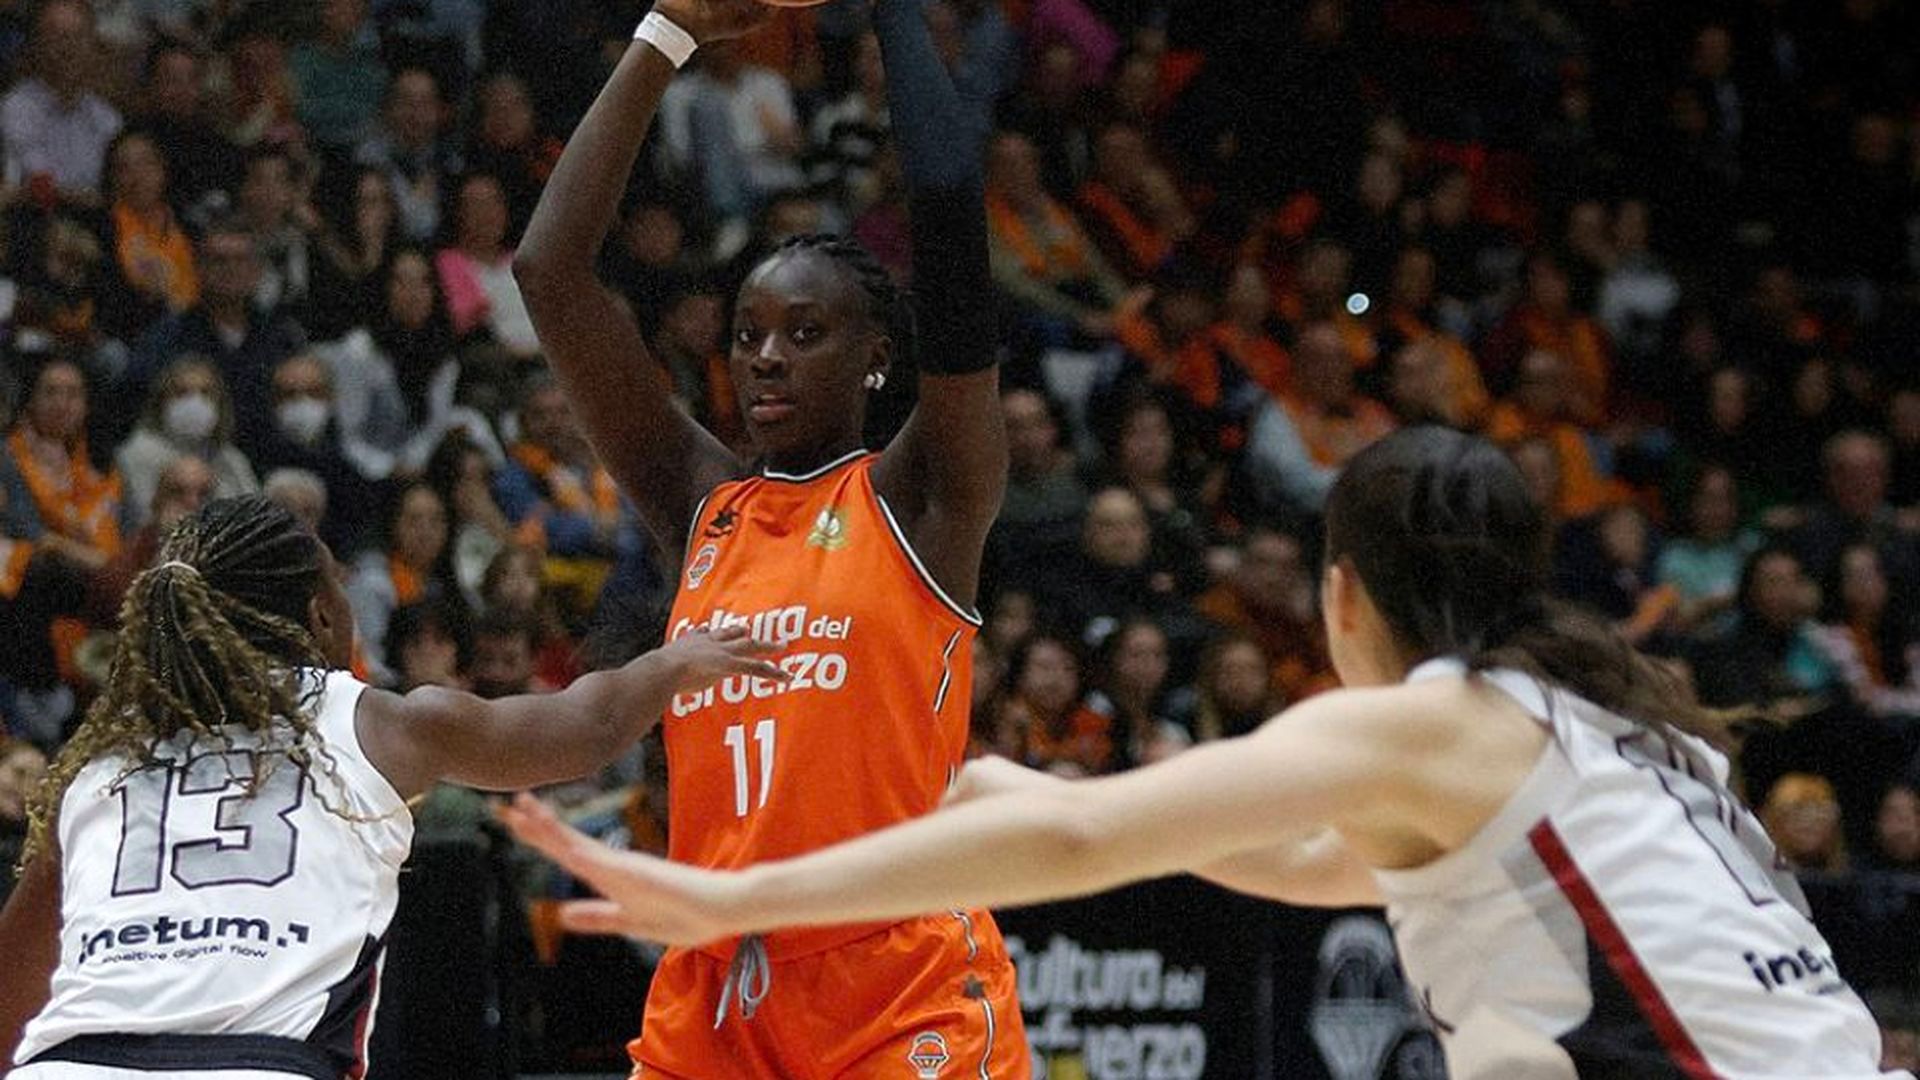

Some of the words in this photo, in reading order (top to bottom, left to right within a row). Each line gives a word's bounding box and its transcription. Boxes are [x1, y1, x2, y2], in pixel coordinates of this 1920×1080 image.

[808, 615, 851, 640] del
[724, 719, 776, 817] 11
[109, 748, 306, 898] 13
[173, 943, 223, 960] digital
[1006, 934, 1163, 1011] ultura
